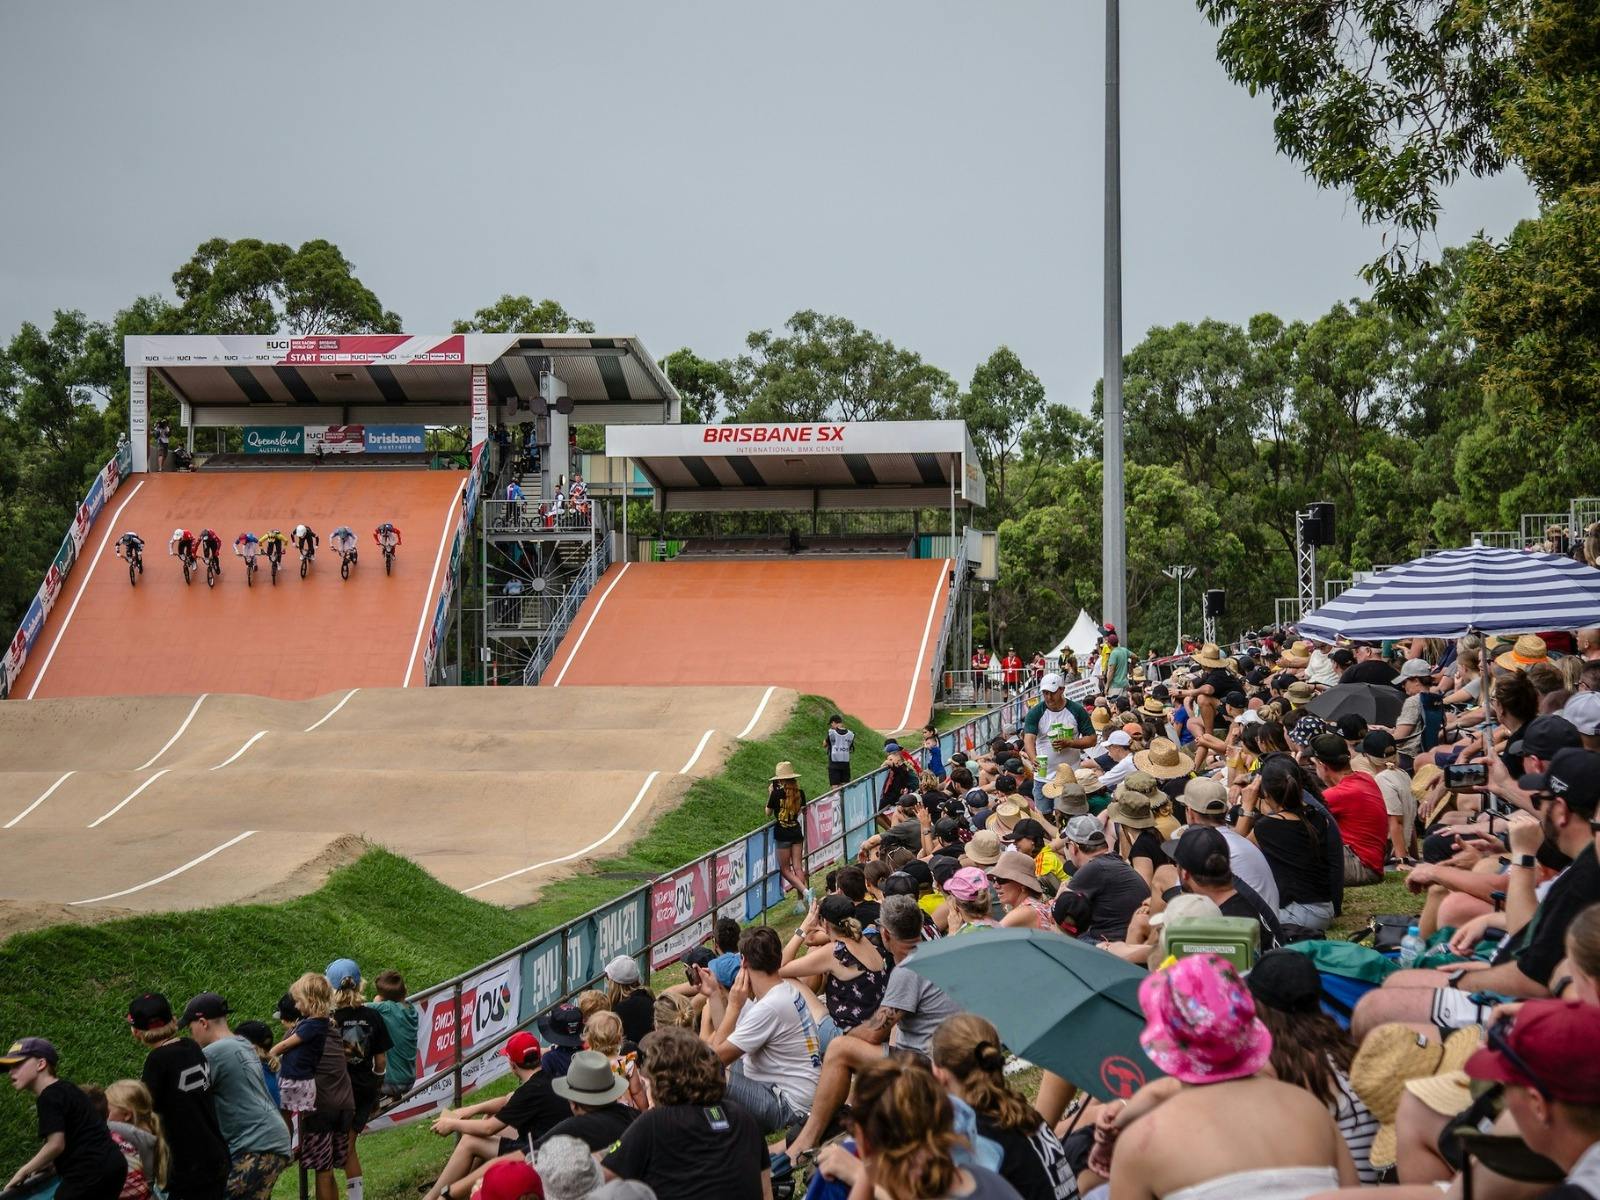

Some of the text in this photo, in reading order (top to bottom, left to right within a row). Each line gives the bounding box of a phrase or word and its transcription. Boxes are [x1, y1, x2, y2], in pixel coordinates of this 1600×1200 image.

[271, 341, 289, 349] UCI
[290, 353, 317, 362] START
[247, 430, 301, 447] Queensland
[368, 433, 421, 444] brisbane
[703, 426, 846, 443] BRISBANE SX
